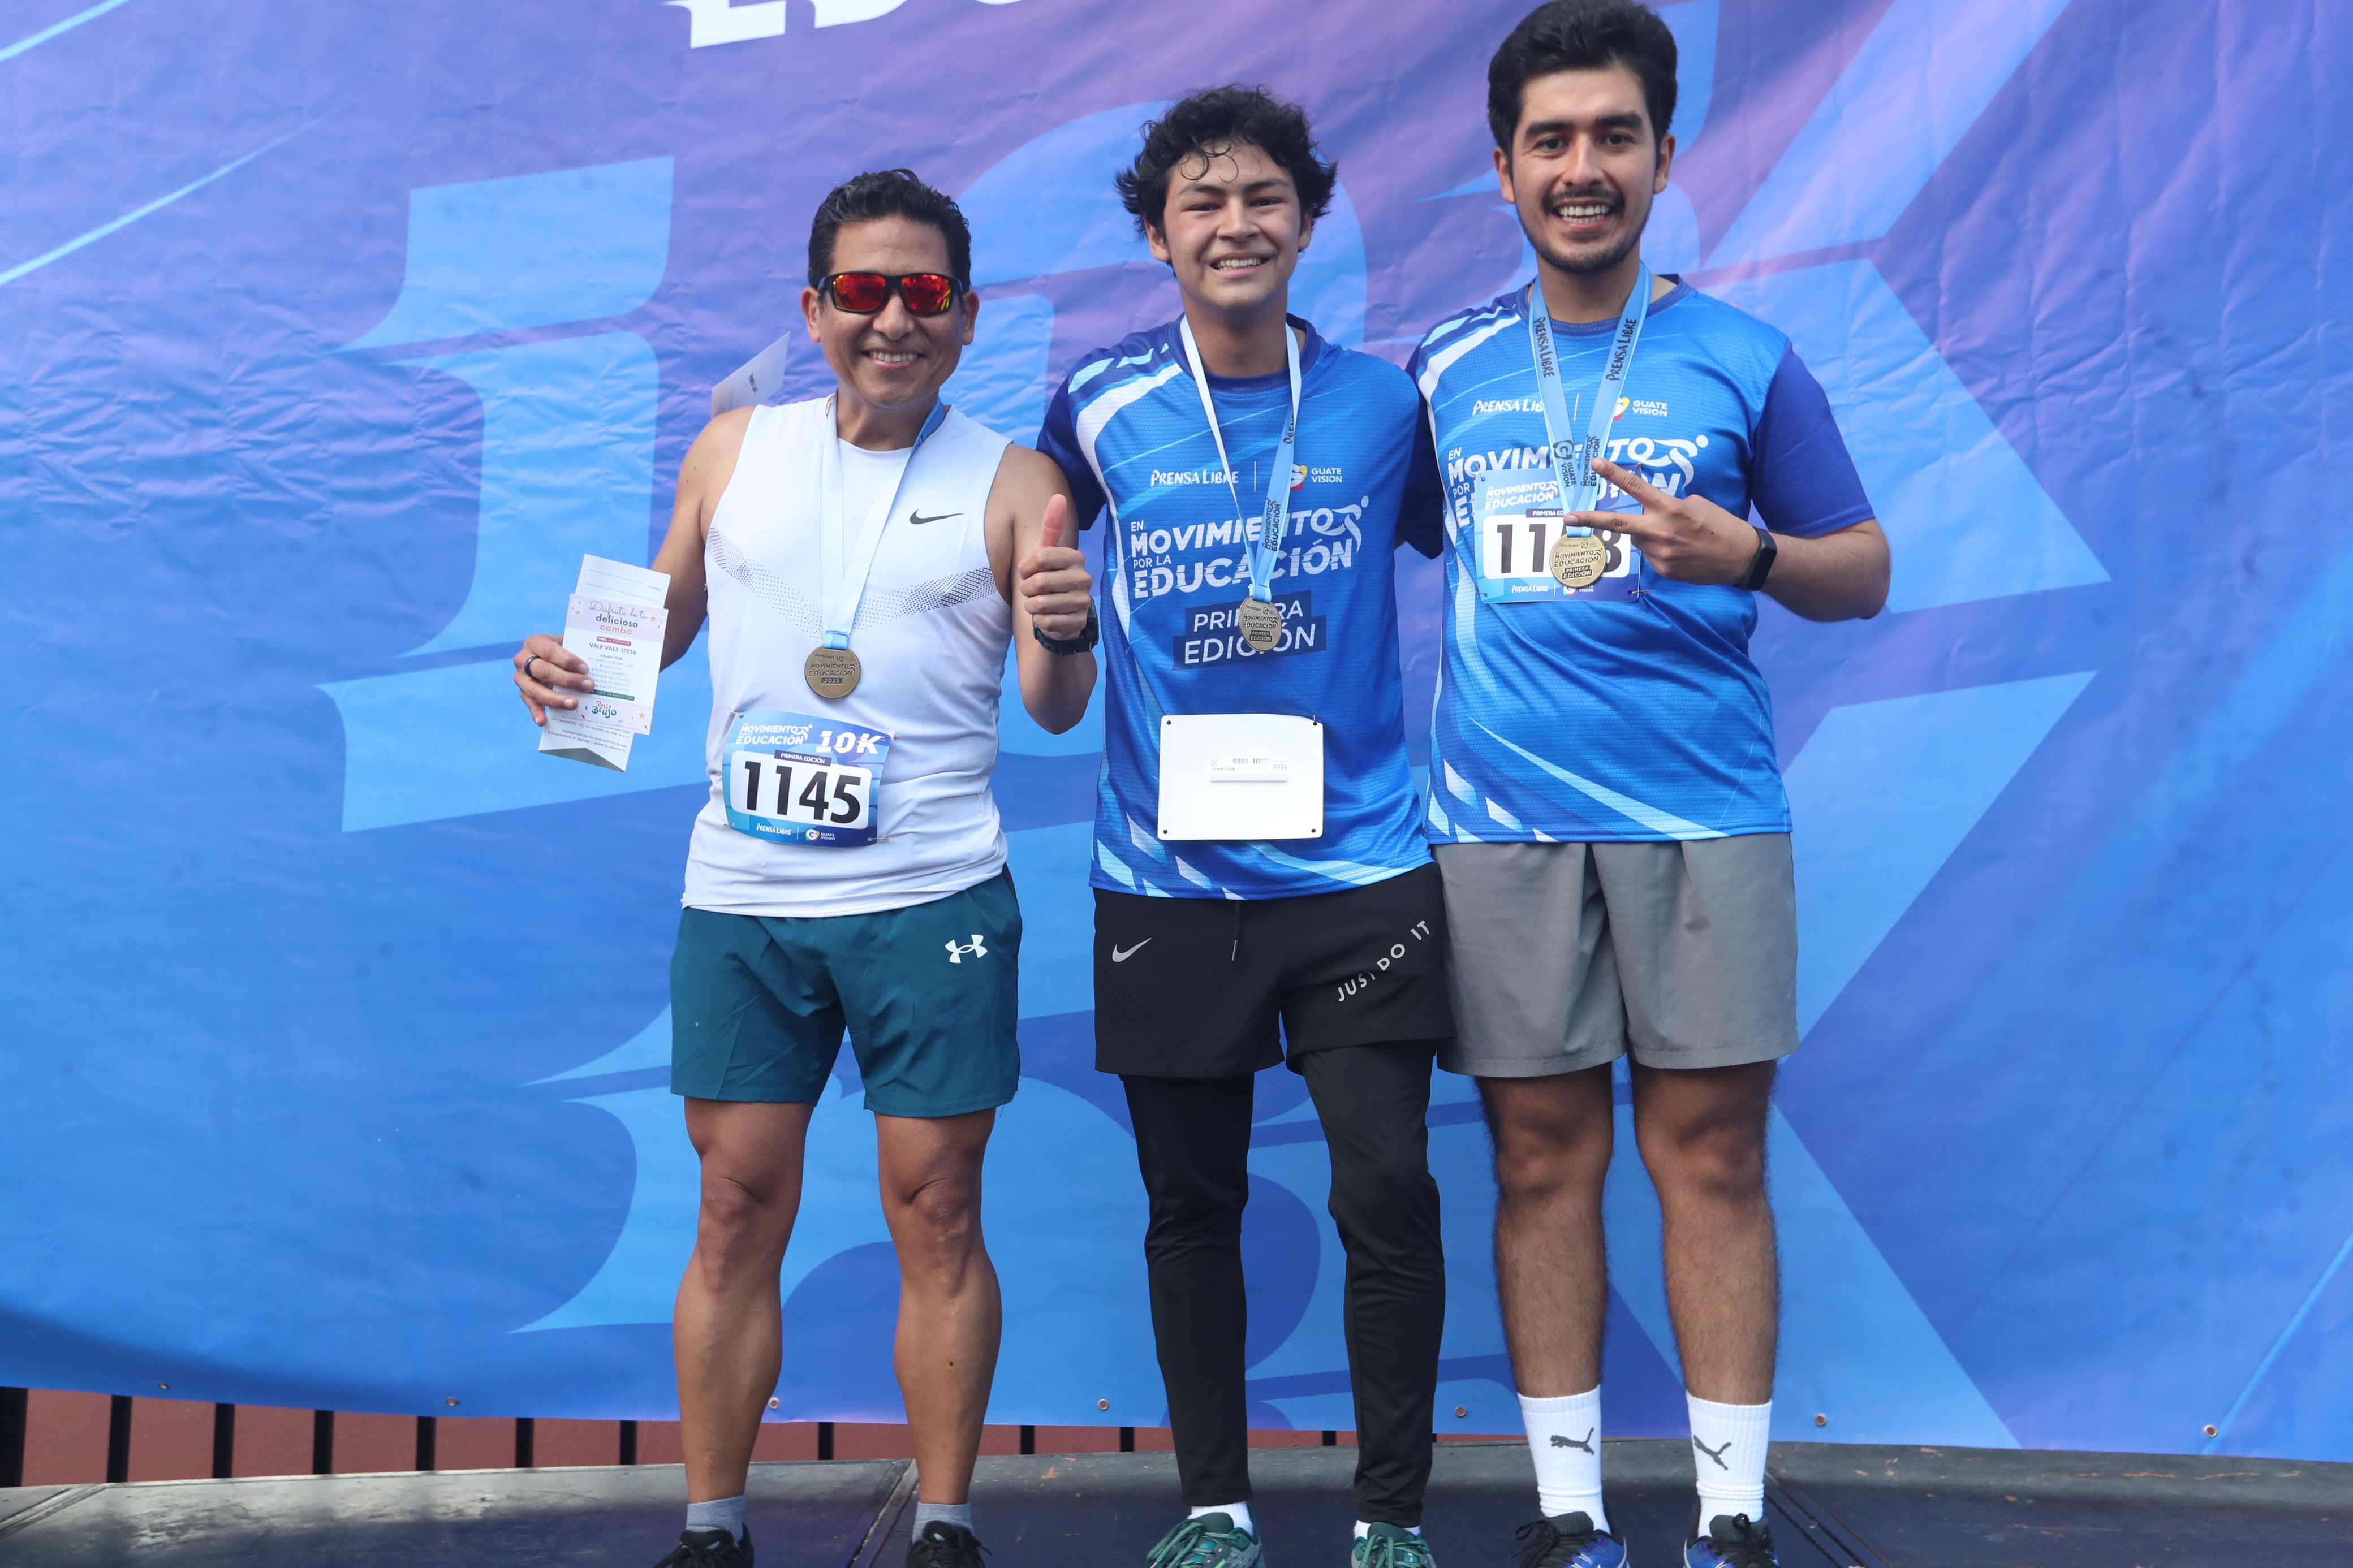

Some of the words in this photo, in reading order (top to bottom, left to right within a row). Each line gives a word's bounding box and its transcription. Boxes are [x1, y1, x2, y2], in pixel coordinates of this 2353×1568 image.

[1534, 316, 1549, 352] PRENSA
[1605, 345, 1628, 381] PRENSA
[1618, 318, 1637, 344] LIBRE
[1540, 351, 1555, 378] LIBRE
[1472, 400, 1520, 417] PRENSA
[1522, 398, 1545, 412] LIB
[1632, 400, 1667, 410] GUATE
[1632, 407, 1667, 417] VISION
[1448, 447, 1462, 460] EN
[1448, 437, 1655, 486] MOVIMTO
[1591, 438, 1600, 486] EDCIÓN
[1151, 470, 1200, 487] PRENSA
[1561, 463, 1572, 487] VISION
[1567, 461, 1577, 486] GUATE
[1453, 482, 1471, 498] POR
[1486, 481, 1547, 498] MOVIMIENTO
[1485, 491, 1554, 511] EDUCACIÓN
[1131, 520, 1144, 532] EN
[1497, 524, 1622, 574] 118
[1133, 557, 1152, 569] POR
[1156, 554, 1172, 565] LA
[1511, 585, 1532, 594] PRENSA
[589, 601, 627, 617] Disfruta
[629, 608, 638, 617] de
[638, 610, 648, 619] tu
[1193, 600, 1303, 632] PRIRA
[596, 614, 638, 628] delicioso
[600, 625, 632, 634] combo
[1184, 622, 1316, 664] EDICÓN
[592, 706, 617, 718] Brujo
[740, 724, 798, 734] MOVIMIENTO
[736, 735, 804, 745] EDUCACIÓN
[816, 730, 883, 754] 10K
[781, 753, 803, 761] PRIMERA
[804, 755, 825, 764] EDICIÓN
[745, 761, 861, 824] 1145
[756, 823, 775, 833] PRENSA
[777, 827, 791, 836] LIBRE
[1377, 944, 1405, 971] DO
[1410, 920, 1430, 940] IT
